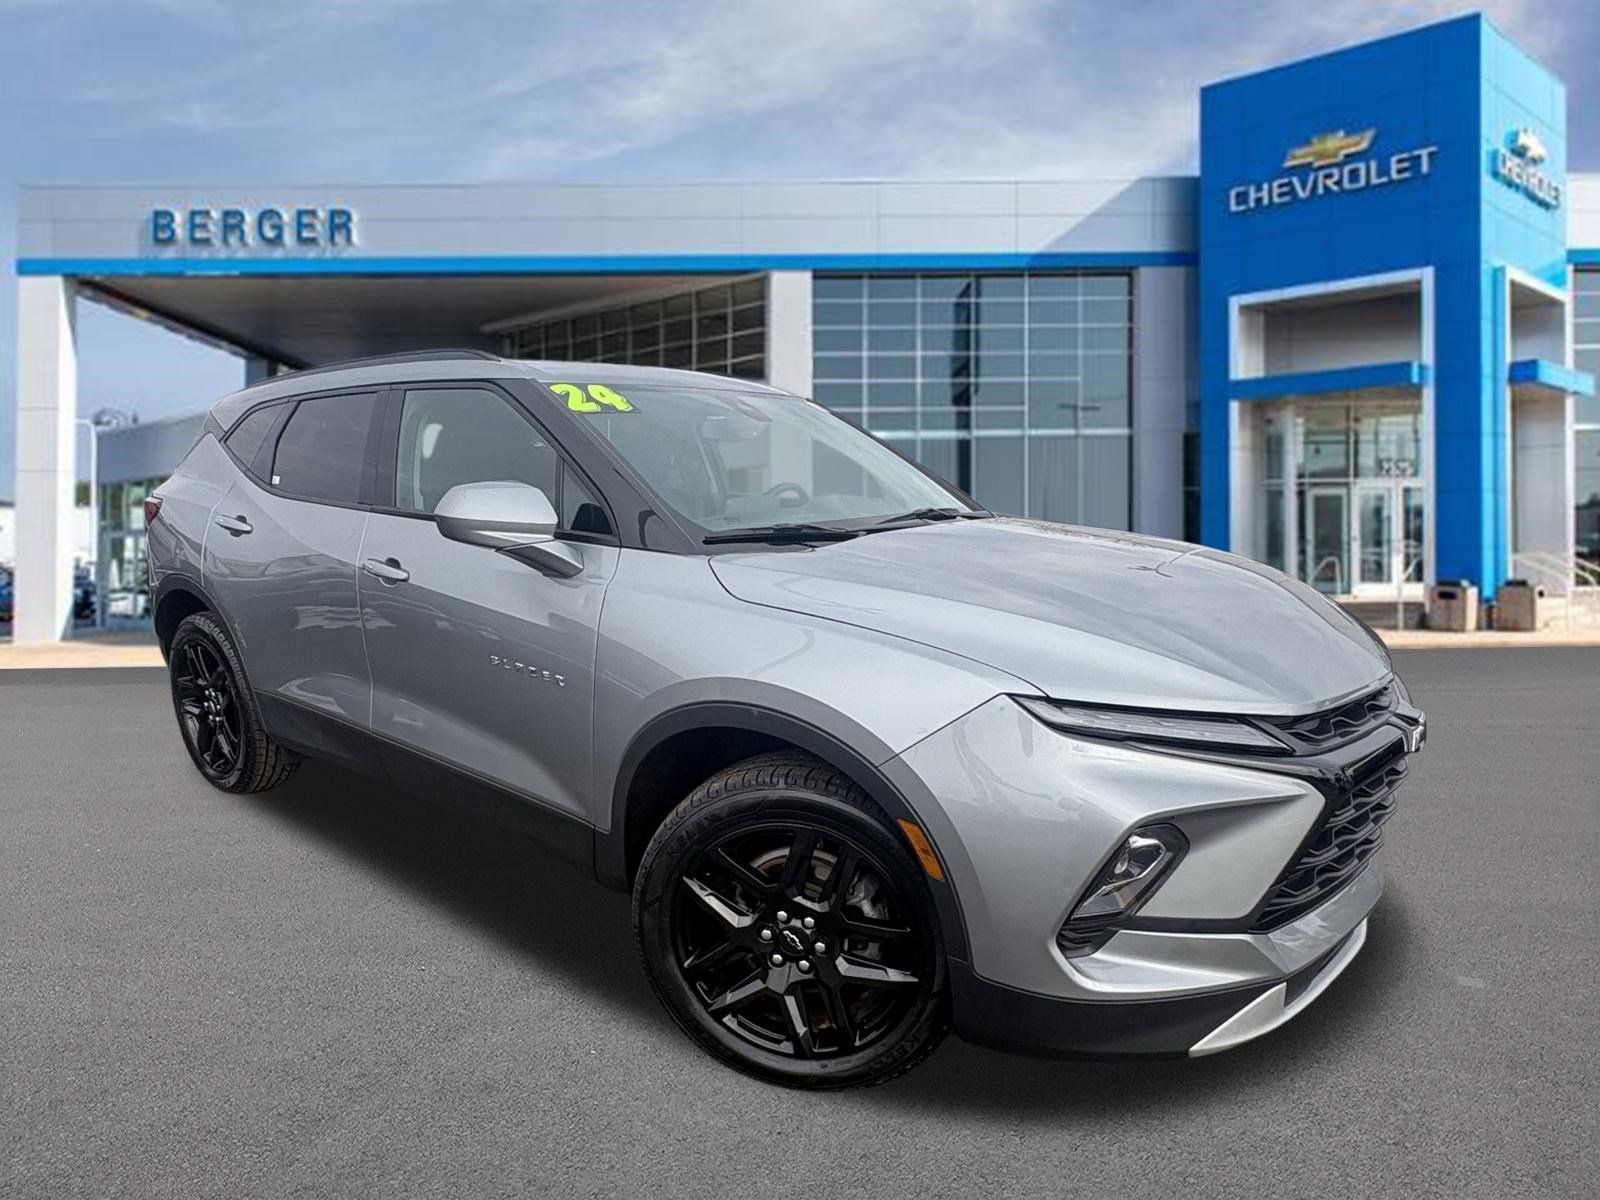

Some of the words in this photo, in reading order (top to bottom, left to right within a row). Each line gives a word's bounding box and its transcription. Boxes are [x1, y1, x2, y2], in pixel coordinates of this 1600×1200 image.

[1229, 145, 1438, 212] CHEVROLET
[152, 208, 355, 246] BERGER
[549, 383, 633, 412] 24
